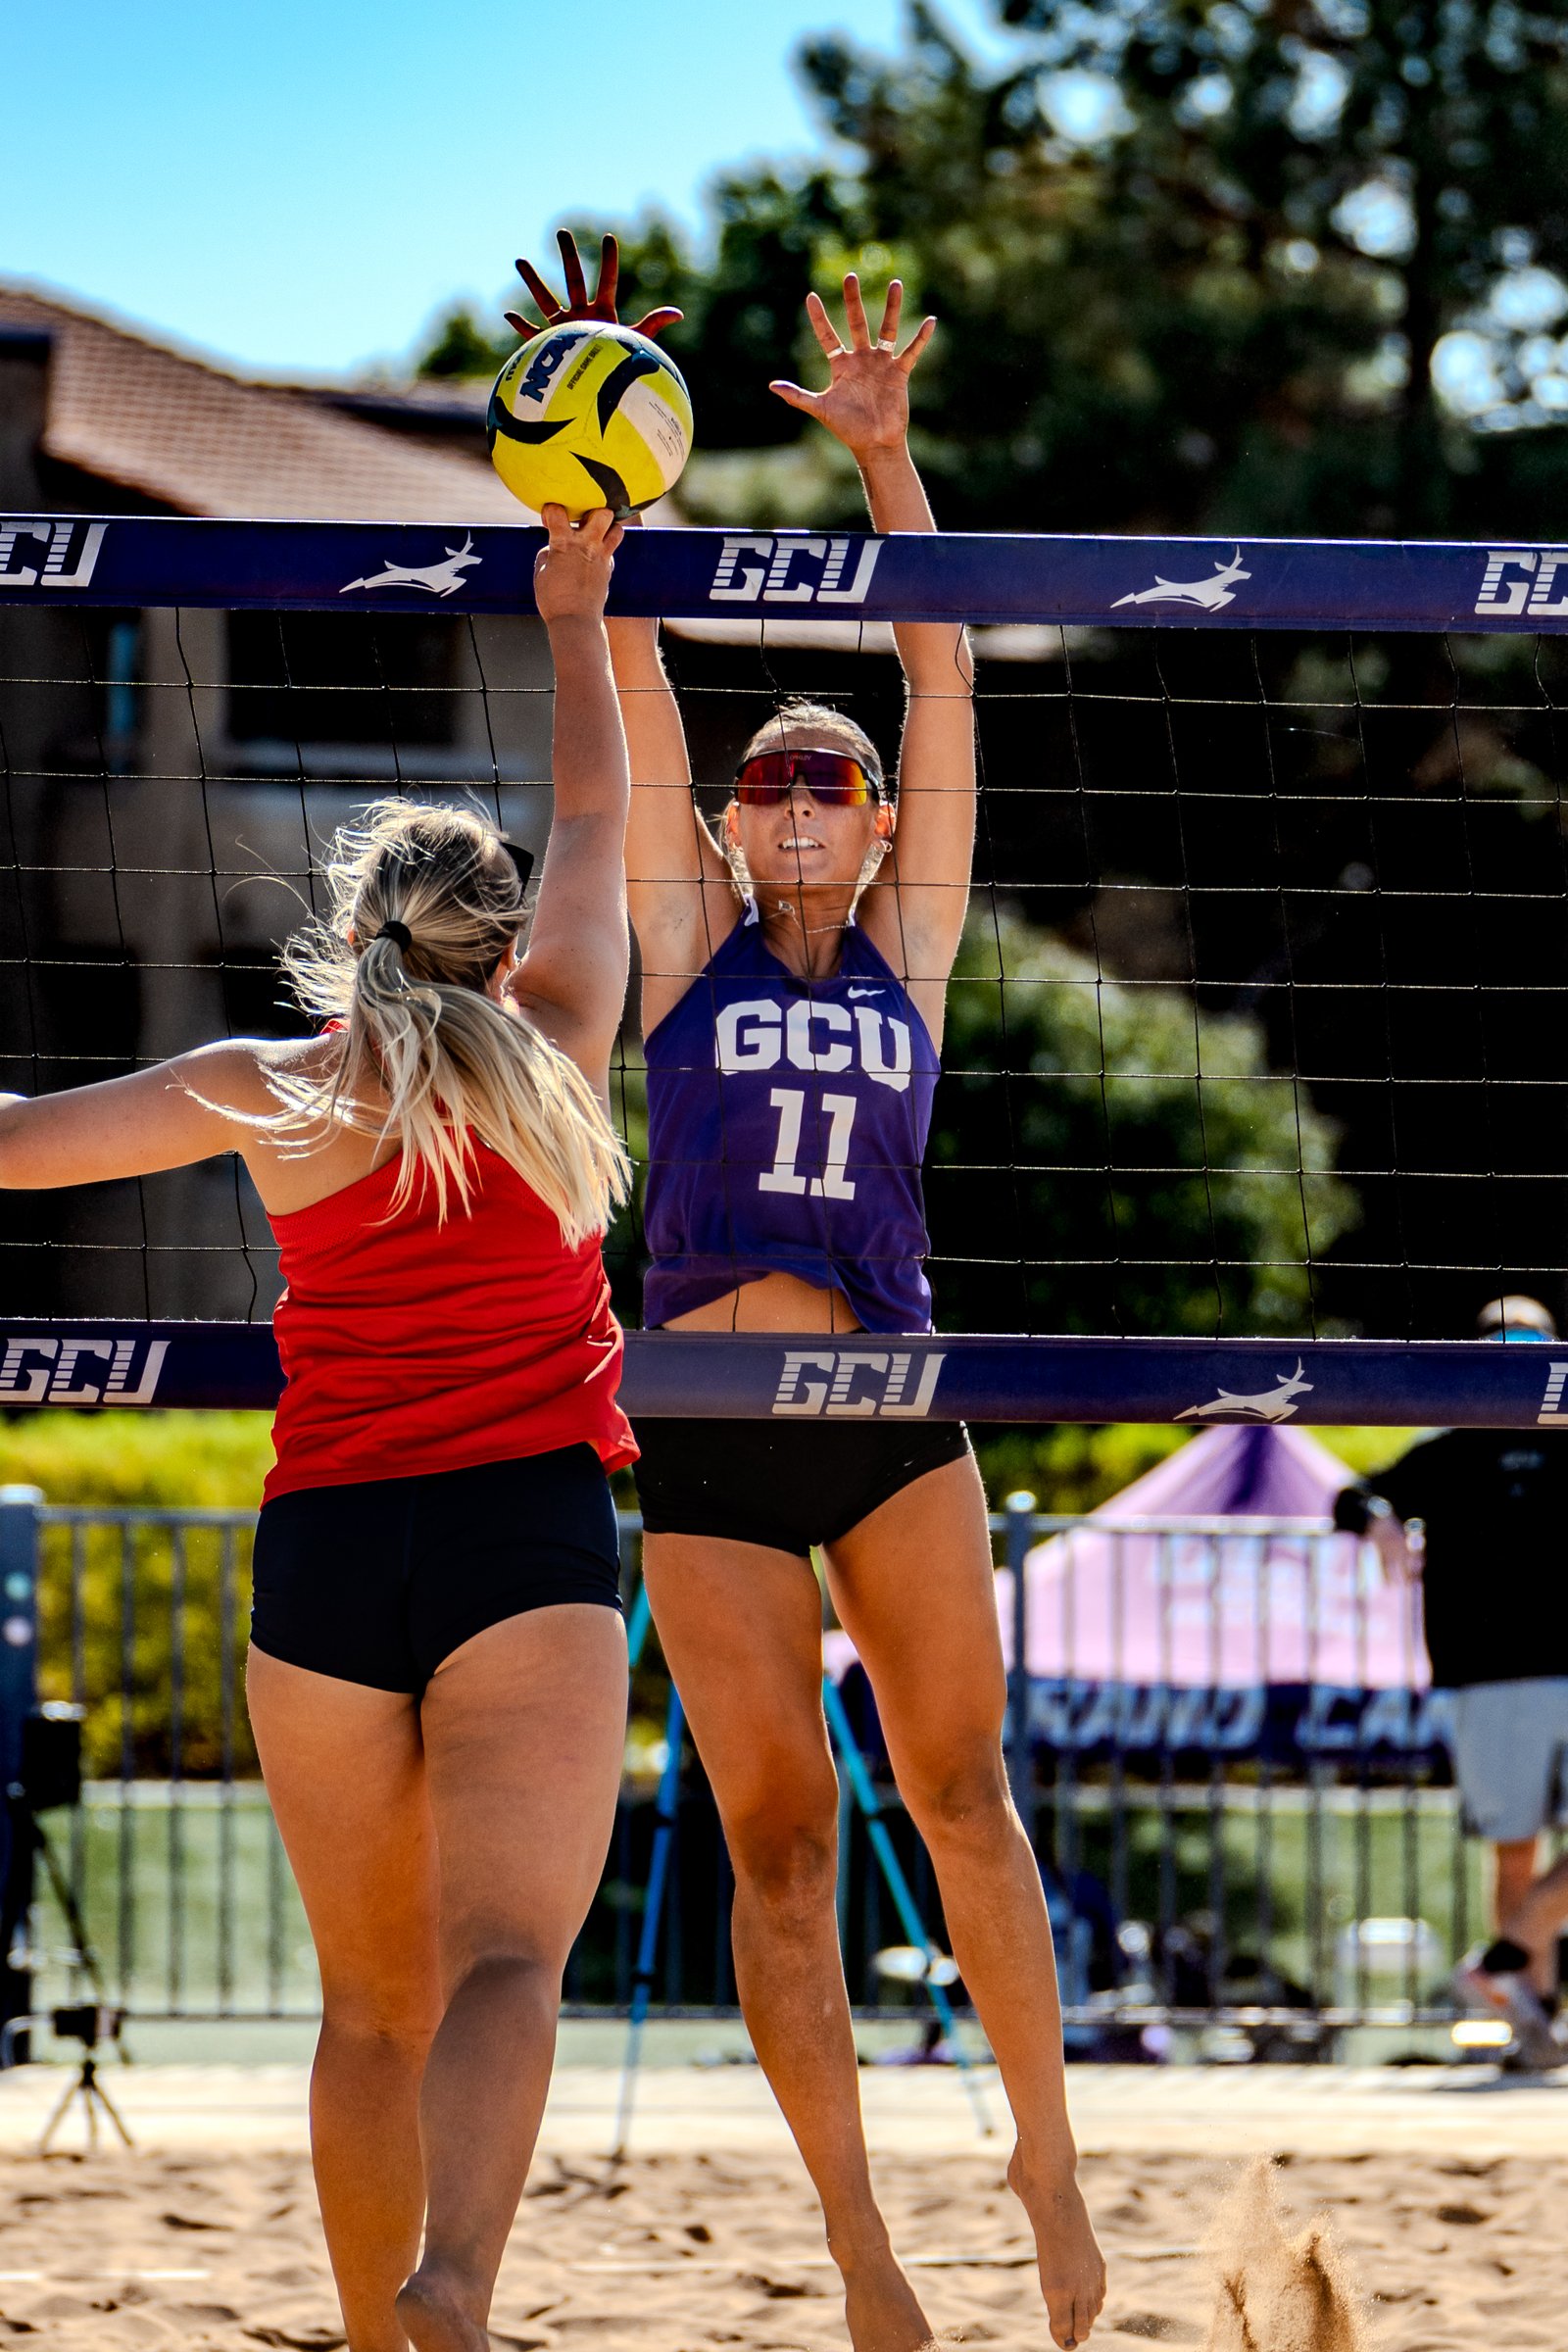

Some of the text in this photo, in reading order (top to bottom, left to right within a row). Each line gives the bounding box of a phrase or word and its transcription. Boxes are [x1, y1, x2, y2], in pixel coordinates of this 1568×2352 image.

[519, 331, 589, 403] NCAA
[566, 368, 584, 390] OFFICIAL
[709, 537, 885, 603] GCU
[715, 999, 912, 1093] GCU
[759, 1088, 857, 1200] 11
[0, 1339, 172, 1403] GCU
[772, 1351, 948, 1416] GCU
[1004, 1678, 1265, 1750] RAND
